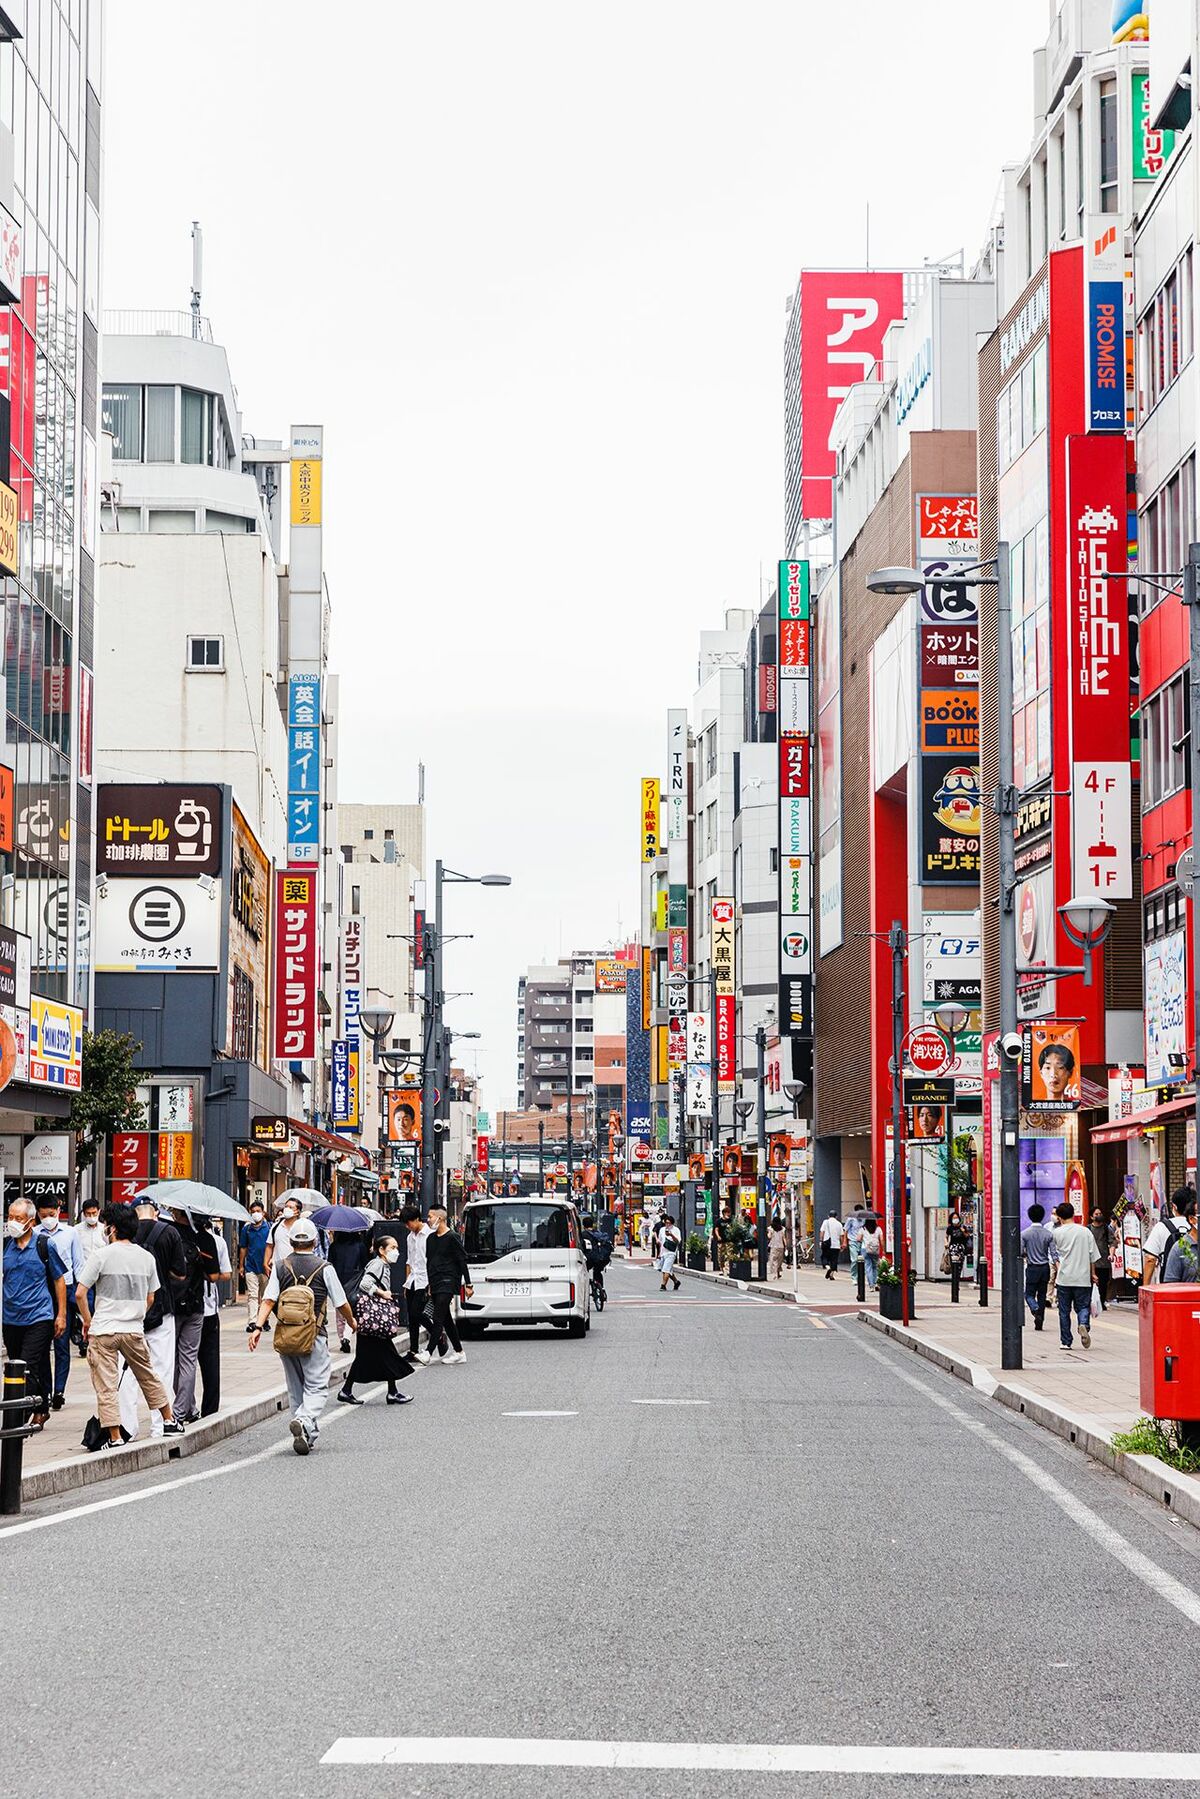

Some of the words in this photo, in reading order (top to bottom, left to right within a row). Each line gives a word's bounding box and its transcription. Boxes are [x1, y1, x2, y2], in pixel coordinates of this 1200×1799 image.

[1096, 303, 1116, 390] PROMISE
[1093, 410, 1121, 420] プロミス
[299, 462, 312, 524] 大宮中央クリニック
[1078, 538, 1087, 602] TAITO
[788, 563, 801, 618] サイゼリヤ
[1089, 538, 1120, 695] GAME
[784, 622, 795, 665] バイキング
[926, 632, 978, 651] ホット
[1079, 606, 1089, 695] STATION
[926, 655, 979, 665] ×暗闇エク
[292, 674, 318, 683] AEON
[766, 667, 776, 711] JOYSOUND
[946, 728, 980, 744] PLUS
[293, 686, 316, 836] 英会話イーオン
[672, 752, 683, 790] TRN
[787, 746, 803, 793] ガスト
[105, 816, 170, 841] ドトール
[790, 799, 800, 853] RAKUUN
[105, 844, 170, 861] 珈琲農園
[294, 846, 312, 858] 5F
[939, 838, 979, 853] 驚安の
[1089, 864, 1117, 887] 1F
[285, 881, 307, 901] 薬
[715, 904, 731, 919] 質
[344, 921, 360, 983] パチンコ
[715, 927, 732, 982] 大黒屋
[284, 909, 308, 1054] サンドラッグ
[958, 986, 981, 994] AGA
[669, 996, 687, 1007] UP
[789, 981, 804, 1030] DOUTOR
[719, 998, 729, 1041] BRAND
[44, 1025, 57, 1048] MINI
[57, 1028, 70, 1052] STOP
[692, 1032, 707, 1060] 松のや
[912, 1043, 944, 1060] 消火栓
[1023, 1033, 1031, 1063] MASATO
[719, 1045, 729, 1078] SHOP
[1023, 1065, 1031, 1084] NUKI
[692, 1081, 707, 1110] すし松
[1063, 1083, 1079, 1098] 46
[412, 1129, 419, 1138] 6
[934, 1125, 944, 1135] 41
[121, 1137, 140, 1203] カラオ
[984, 1168, 993, 1286] AMUSEMENT
